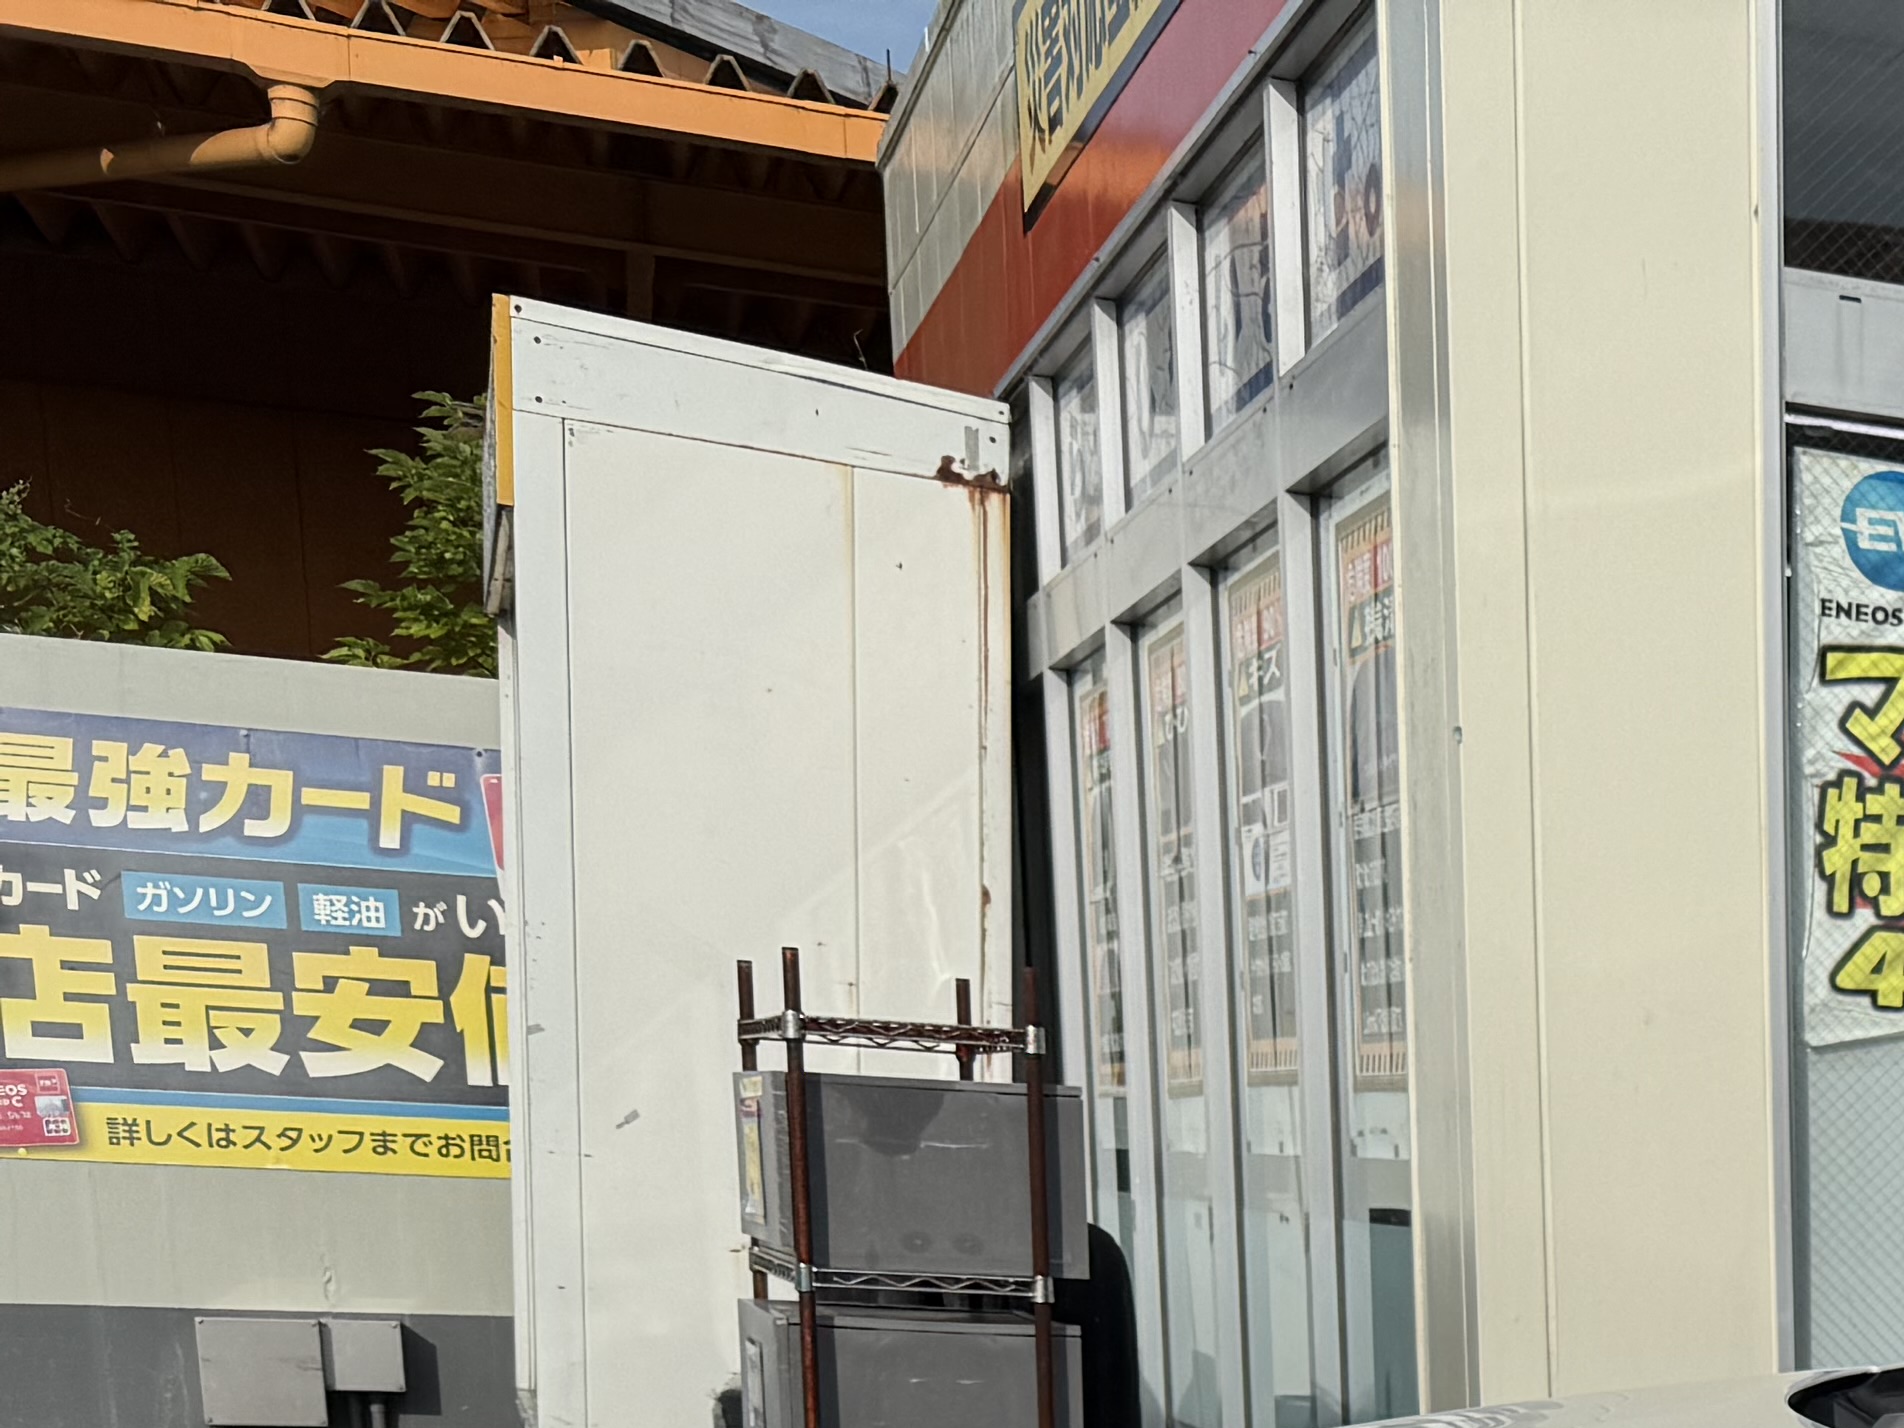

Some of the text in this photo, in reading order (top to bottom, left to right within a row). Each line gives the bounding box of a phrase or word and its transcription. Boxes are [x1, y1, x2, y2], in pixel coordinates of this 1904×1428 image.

[1819, 598, 1901, 626] ENEOS
[0, 730, 462, 850] 最強カード
[135, 880, 273, 918] ガソリン
[312, 892, 387, 929] 軽油
